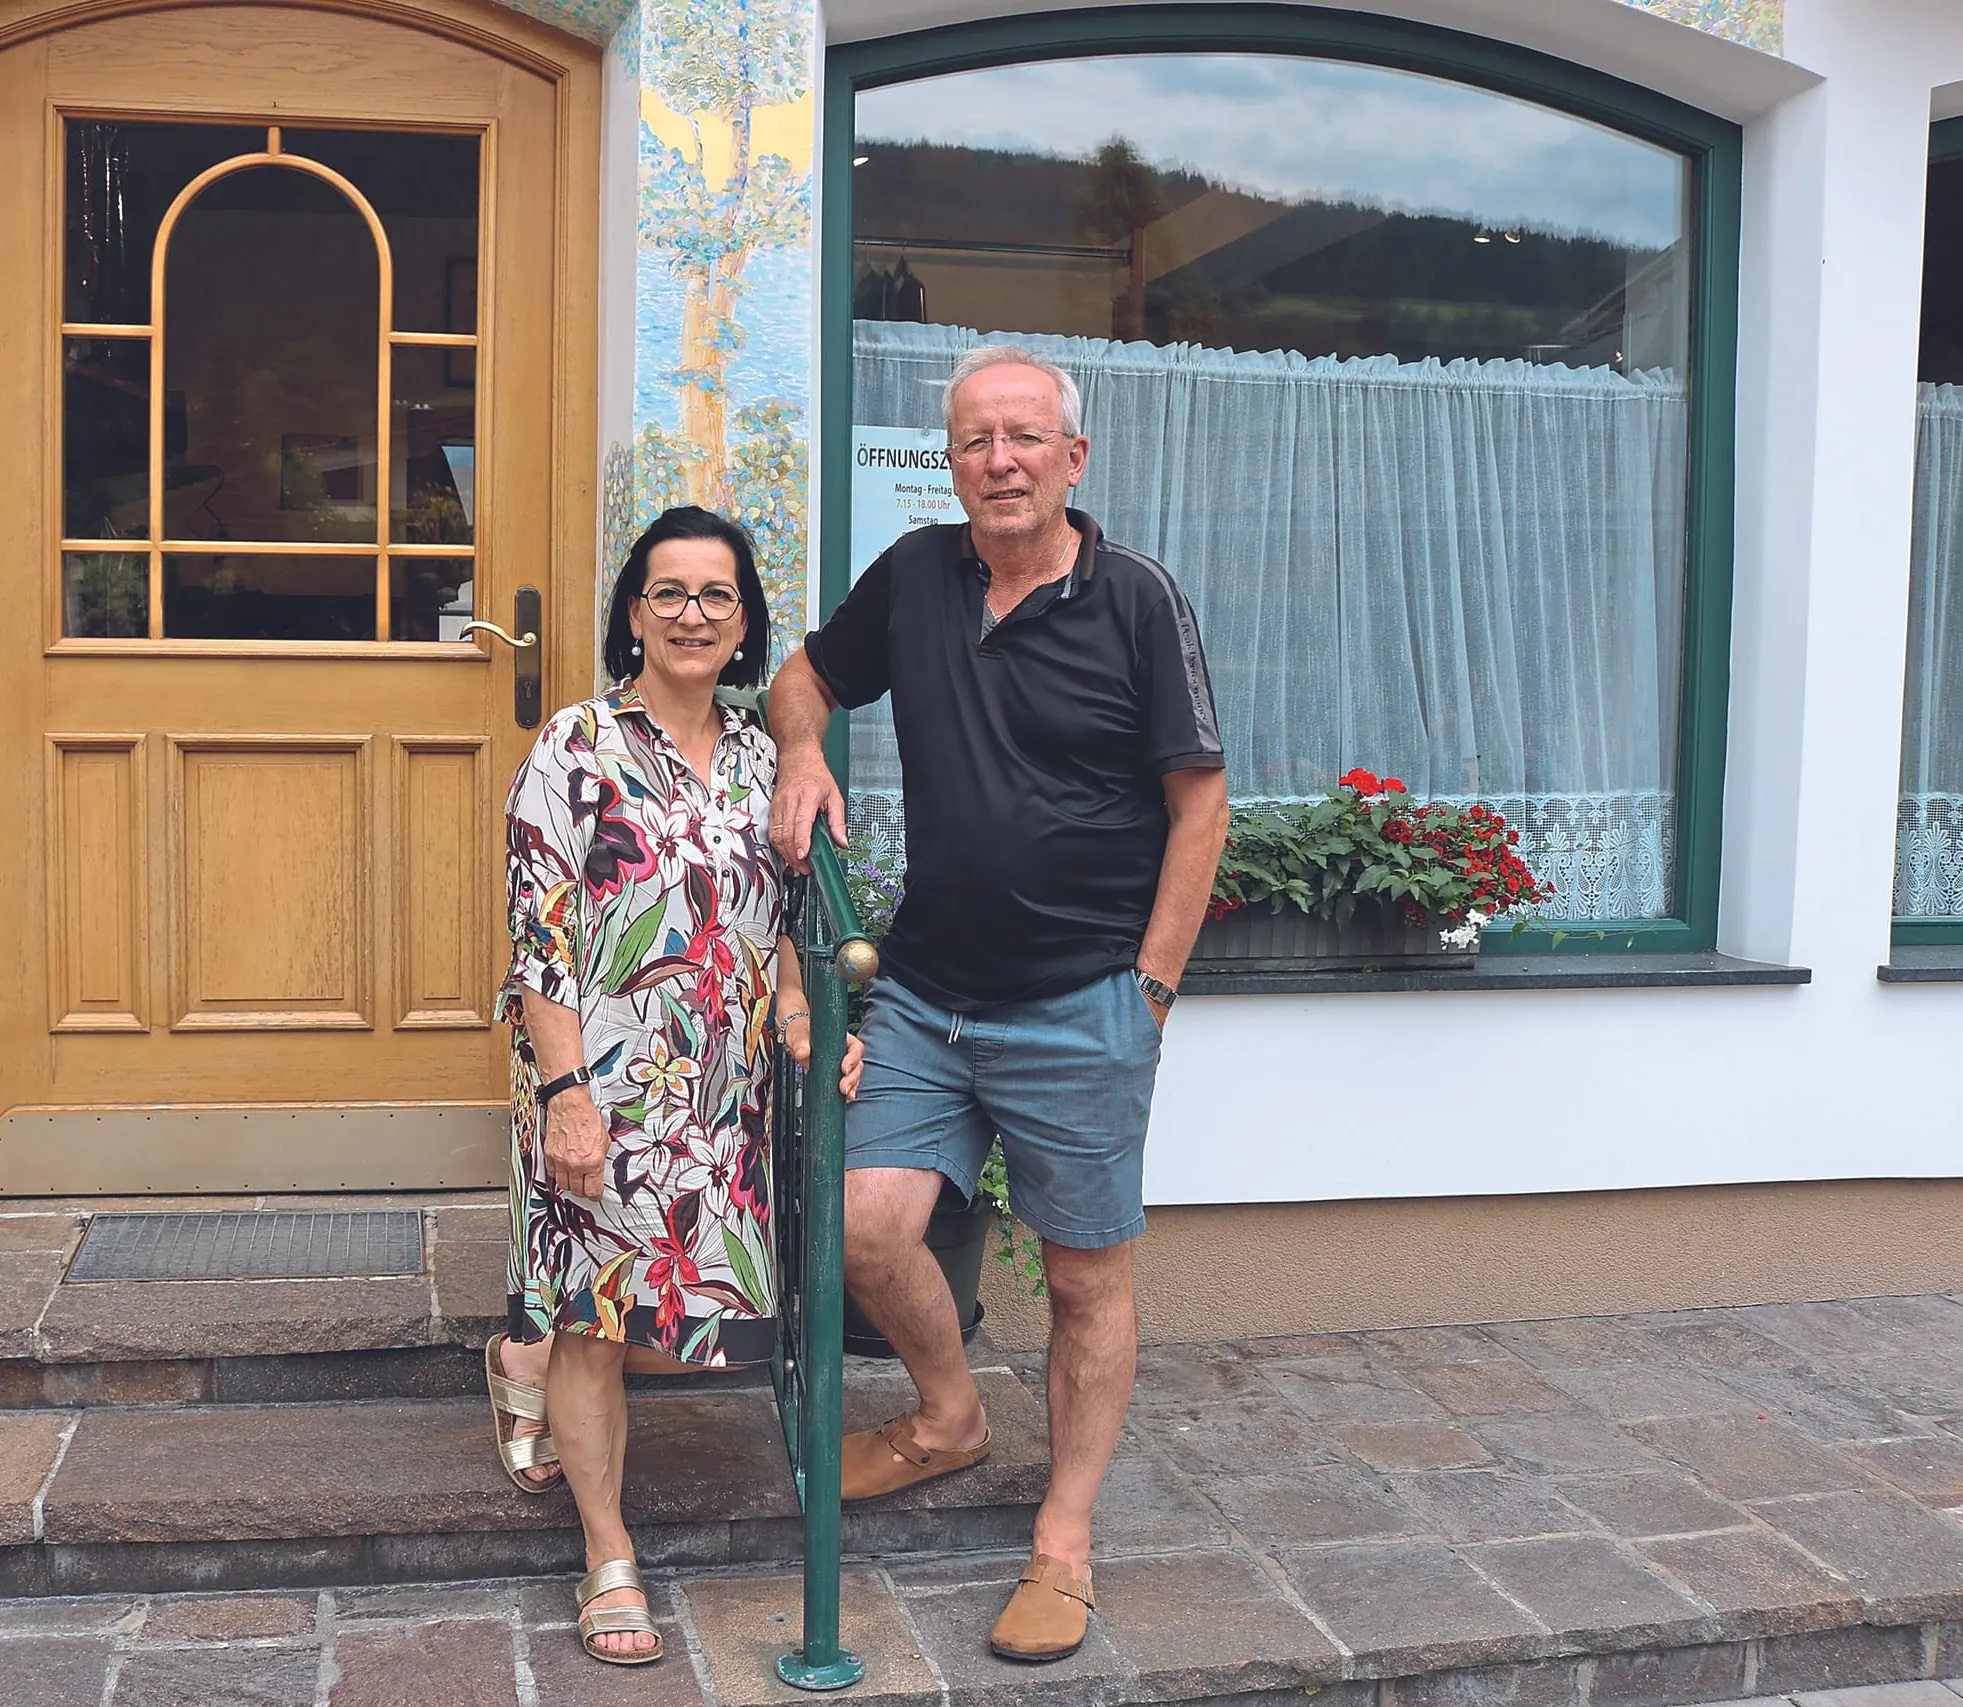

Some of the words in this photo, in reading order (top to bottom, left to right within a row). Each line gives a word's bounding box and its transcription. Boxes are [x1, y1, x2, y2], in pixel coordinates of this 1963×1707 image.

[857, 443, 952, 470] ÖFFNUNGSZ
[895, 483, 922, 496] Montag
[927, 484, 952, 497] Freitag
[896, 499, 911, 508] 7.15
[917, 500, 936, 509] 18.00
[938, 501, 950, 509] Uhr
